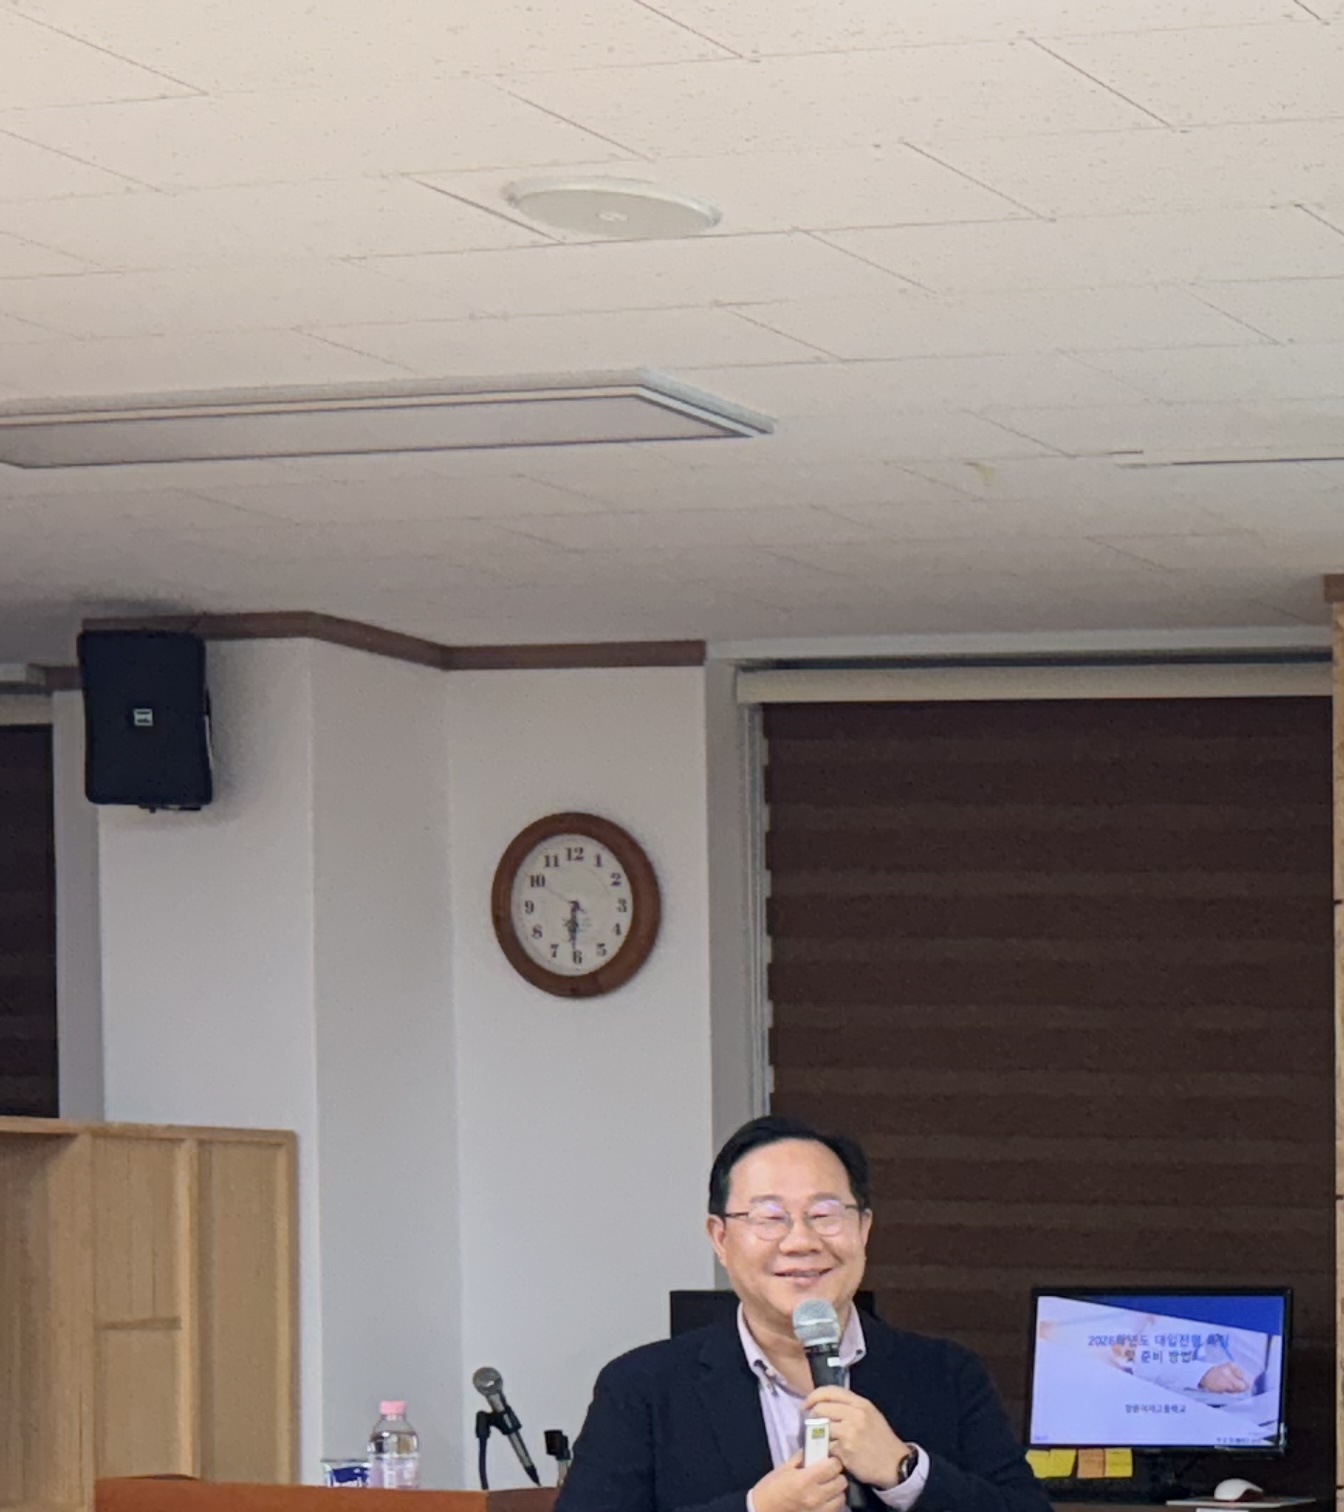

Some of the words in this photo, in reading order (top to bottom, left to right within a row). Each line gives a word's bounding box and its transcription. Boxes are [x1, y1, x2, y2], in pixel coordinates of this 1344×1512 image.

[566, 847, 584, 861] 12
[544, 855, 559, 868] 11
[595, 855, 603, 868] 1
[530, 874, 546, 888] 10
[610, 873, 622, 887] 2
[524, 901, 535, 914] 9
[616, 898, 628, 913] 3
[532, 924, 543, 939] 8
[550, 944, 559, 958] 7
[573, 950, 583, 964] 6
[596, 943, 607, 957] 5
